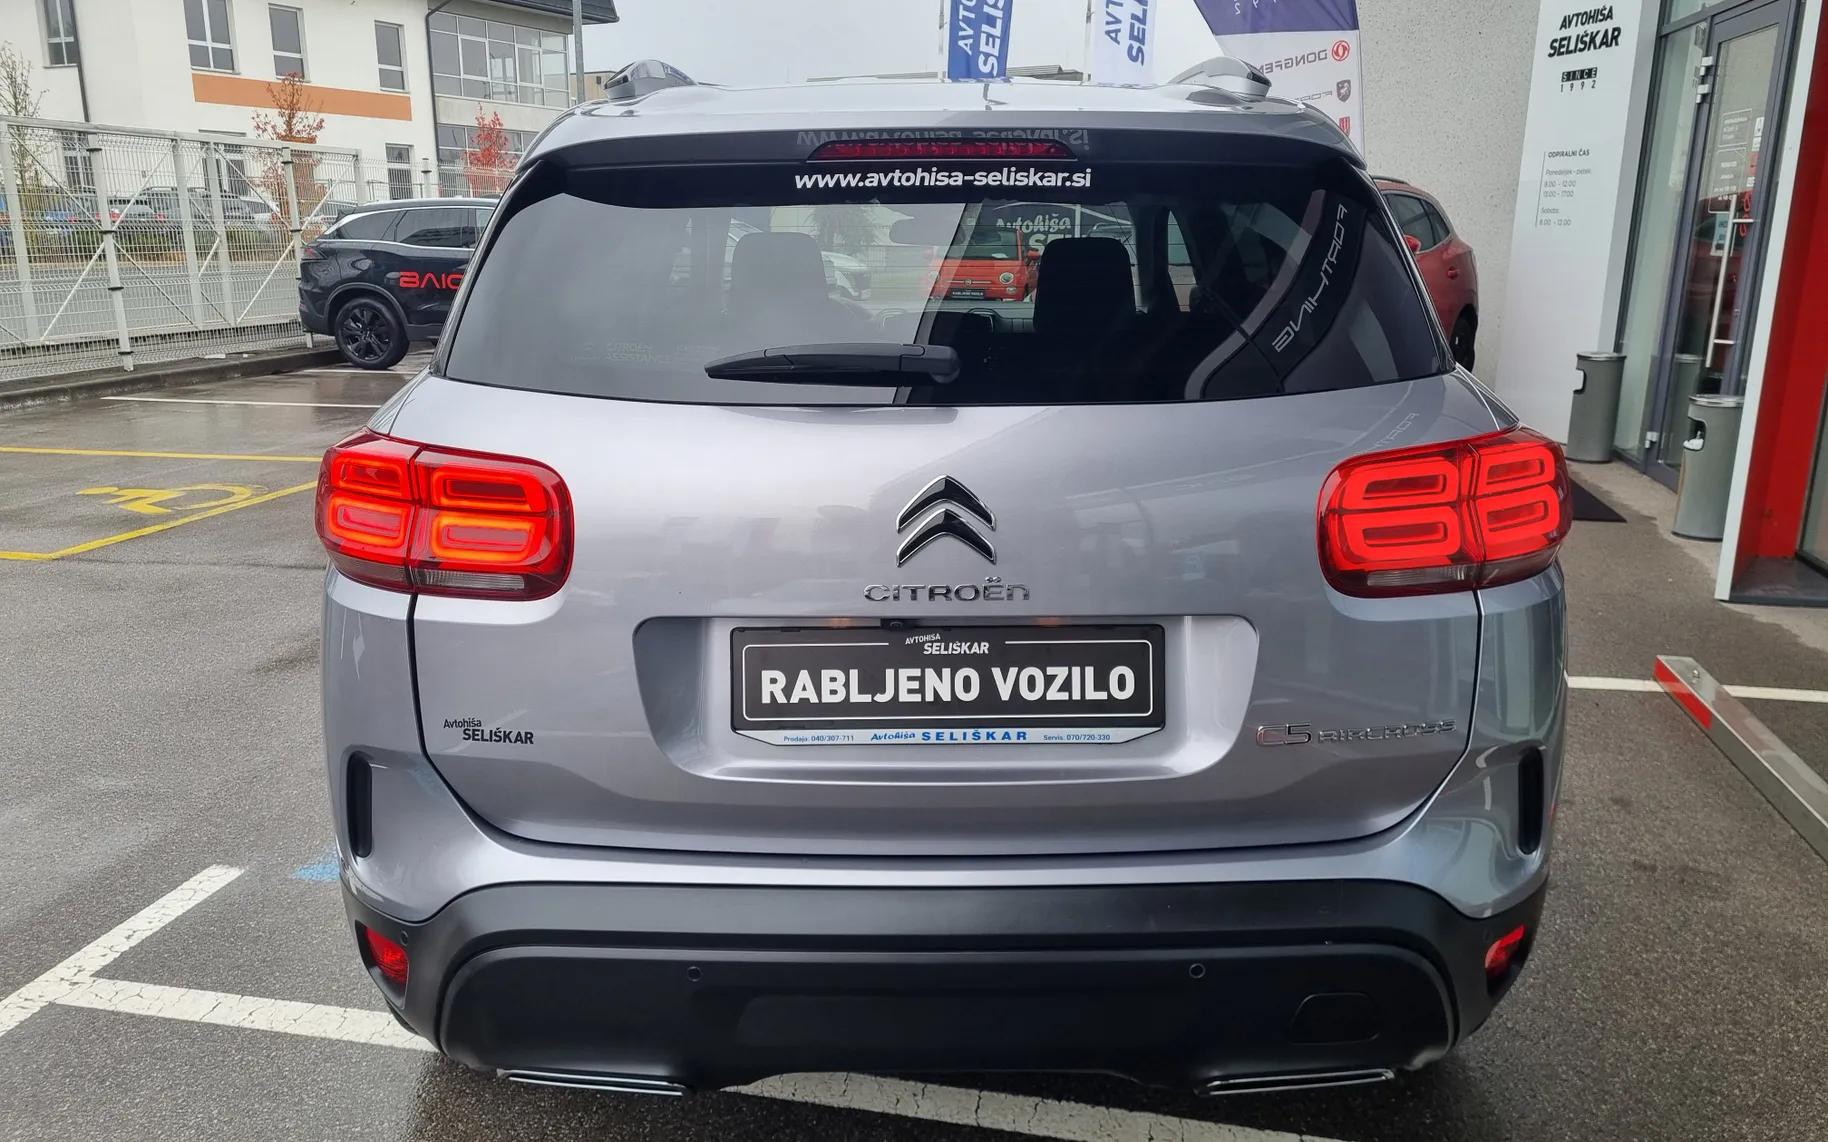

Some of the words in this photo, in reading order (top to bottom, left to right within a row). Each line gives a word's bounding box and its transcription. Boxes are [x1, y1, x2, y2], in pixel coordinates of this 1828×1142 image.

[1559, 4, 1613, 31] AVTOHIŠA
[1547, 26, 1622, 58] SELIŠKAR
[1561, 67, 1597, 82] SINCE
[1560, 79, 1596, 93] 1992
[1548, 150, 1578, 158] ODPIRALNI
[1578, 148, 1590, 157] ČAS
[794, 167, 1092, 188] www.avtohisa-seliskar.si
[400, 271, 464, 290] BAIC
[923, 641, 990, 655] SELIŠKAR
[760, 667, 981, 704] RABLJENO
[992, 664, 1136, 700] VOZILO
[443, 717, 482, 729] Avtohiša
[462, 727, 534, 745] SELIŠKAR
[870, 731, 916, 741] Avtohiša
[921, 729, 1027, 741] SELIŠKAR
[1256, 722, 1312, 747] C5
[1318, 719, 1457, 744] AIRCROSS
